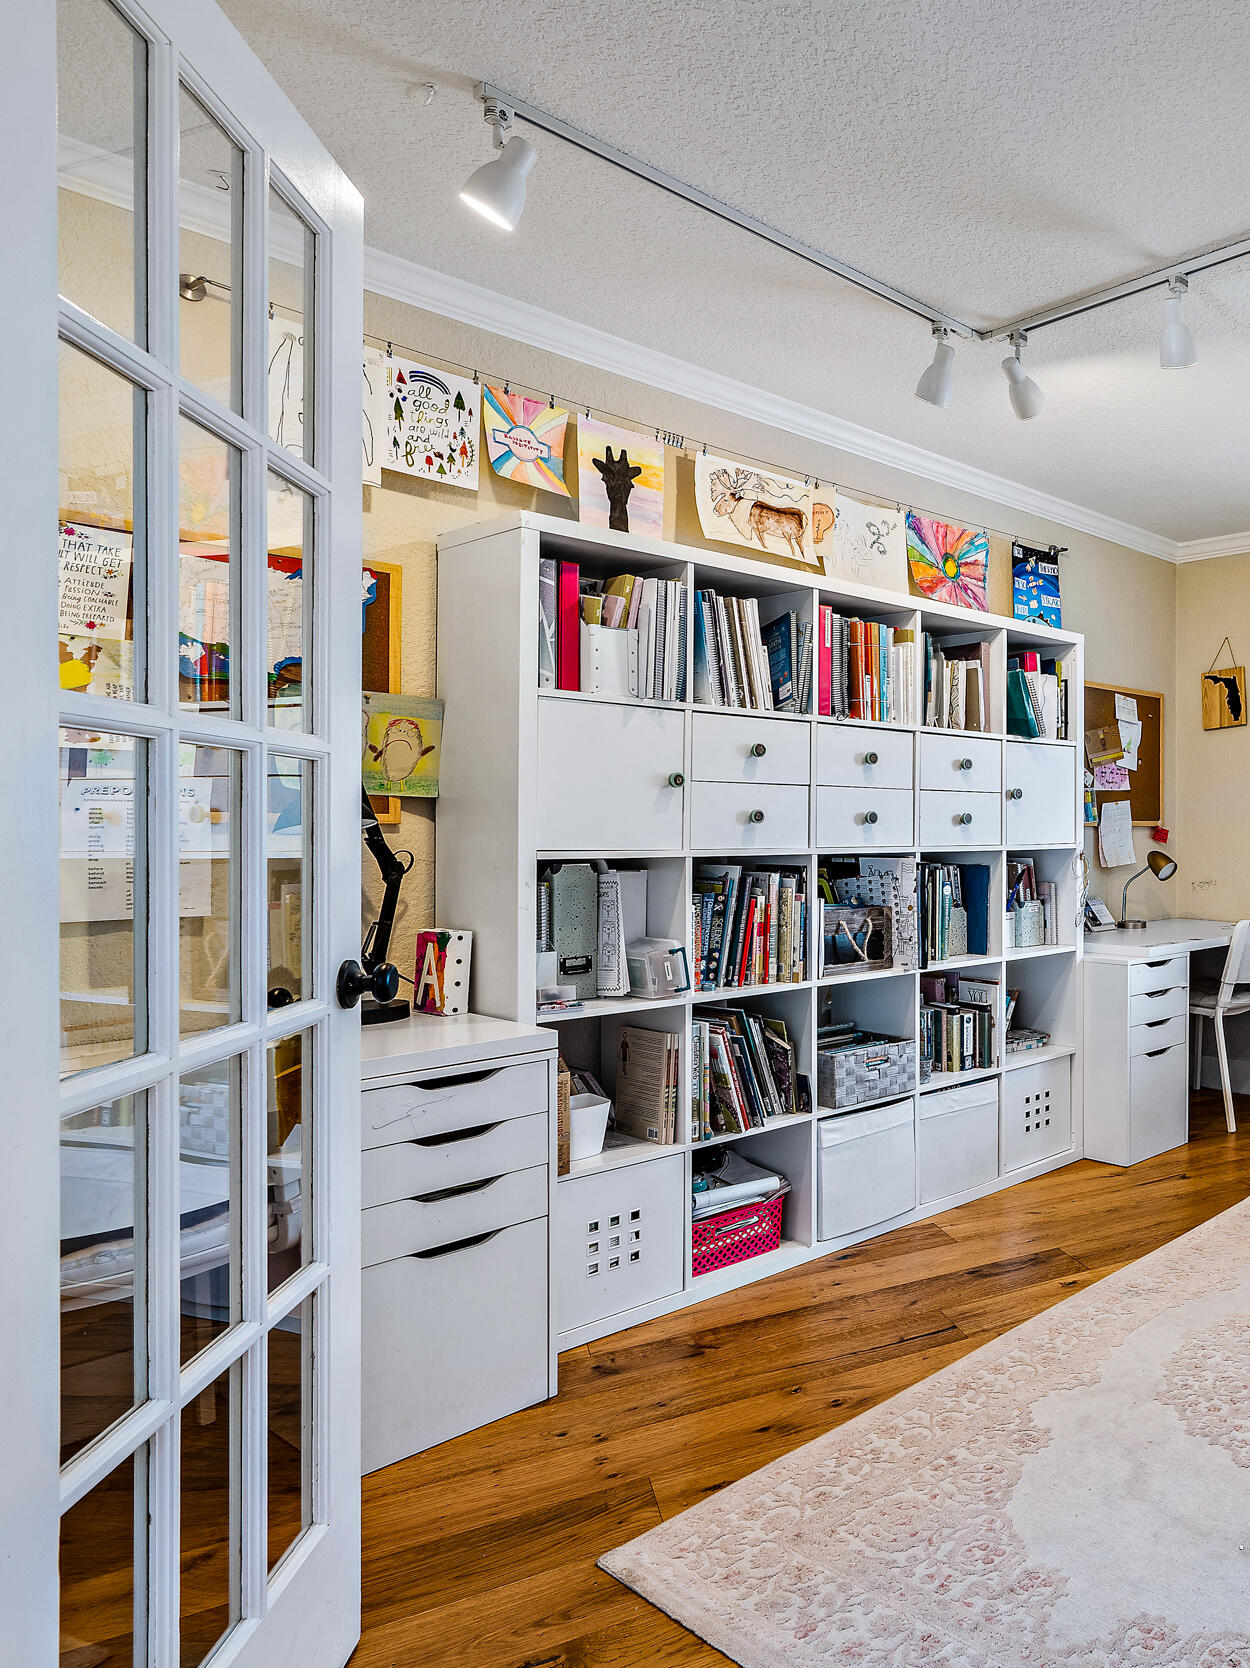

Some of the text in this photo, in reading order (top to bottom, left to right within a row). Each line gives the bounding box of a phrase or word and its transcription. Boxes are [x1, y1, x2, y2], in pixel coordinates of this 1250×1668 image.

[408, 385, 432, 400] all
[412, 399, 450, 414] good
[410, 411, 449, 429] things
[407, 434, 430, 444] and
[429, 428, 449, 439] wild
[62, 539, 122, 557] THAT TAKE
[74, 551, 99, 564] WILL
[102, 558, 123, 569] GET
[63, 561, 103, 576] RESPECT
[715, 918, 723, 949] SCIENCE
[416, 942, 441, 1007] A
